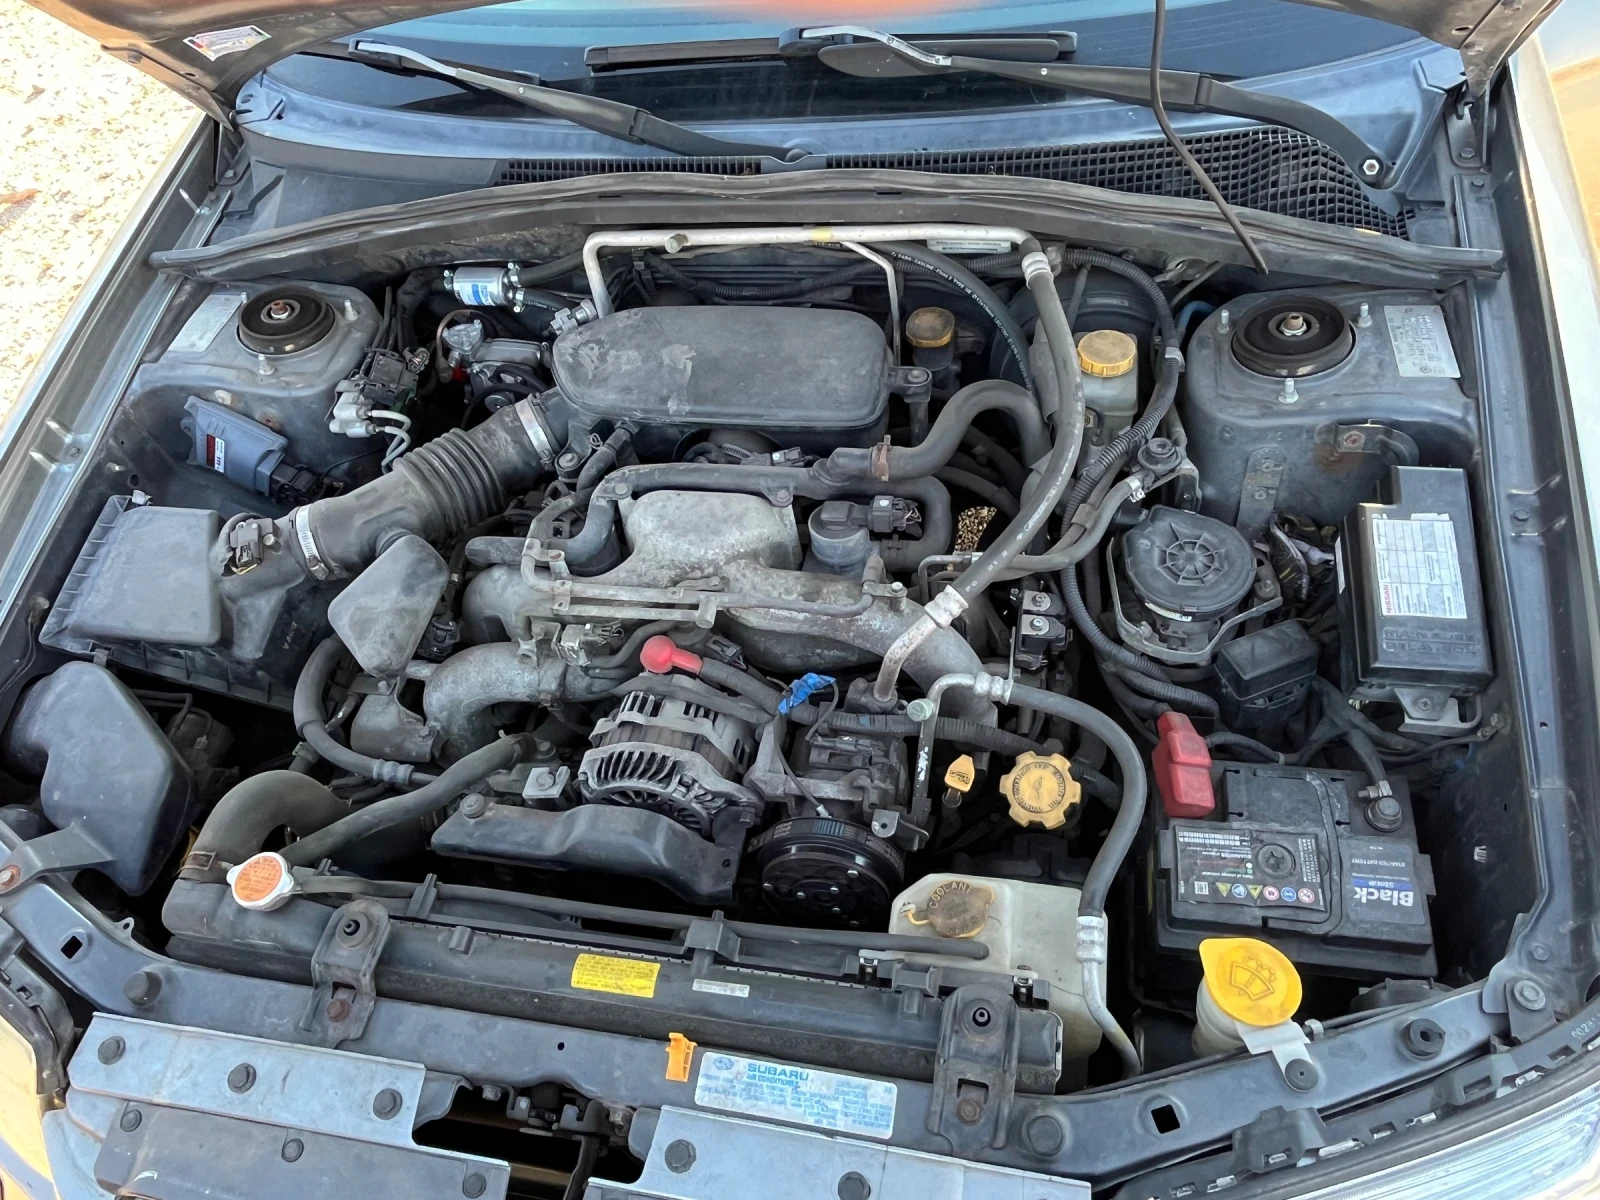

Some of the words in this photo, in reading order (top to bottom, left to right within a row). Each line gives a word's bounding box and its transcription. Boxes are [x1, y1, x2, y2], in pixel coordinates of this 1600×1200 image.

[1384, 585, 1392, 614] NISSAN
[929, 881, 975, 909] COOLANT
[1353, 886, 1414, 907] Black
[748, 1063, 809, 1081] SUBARU
